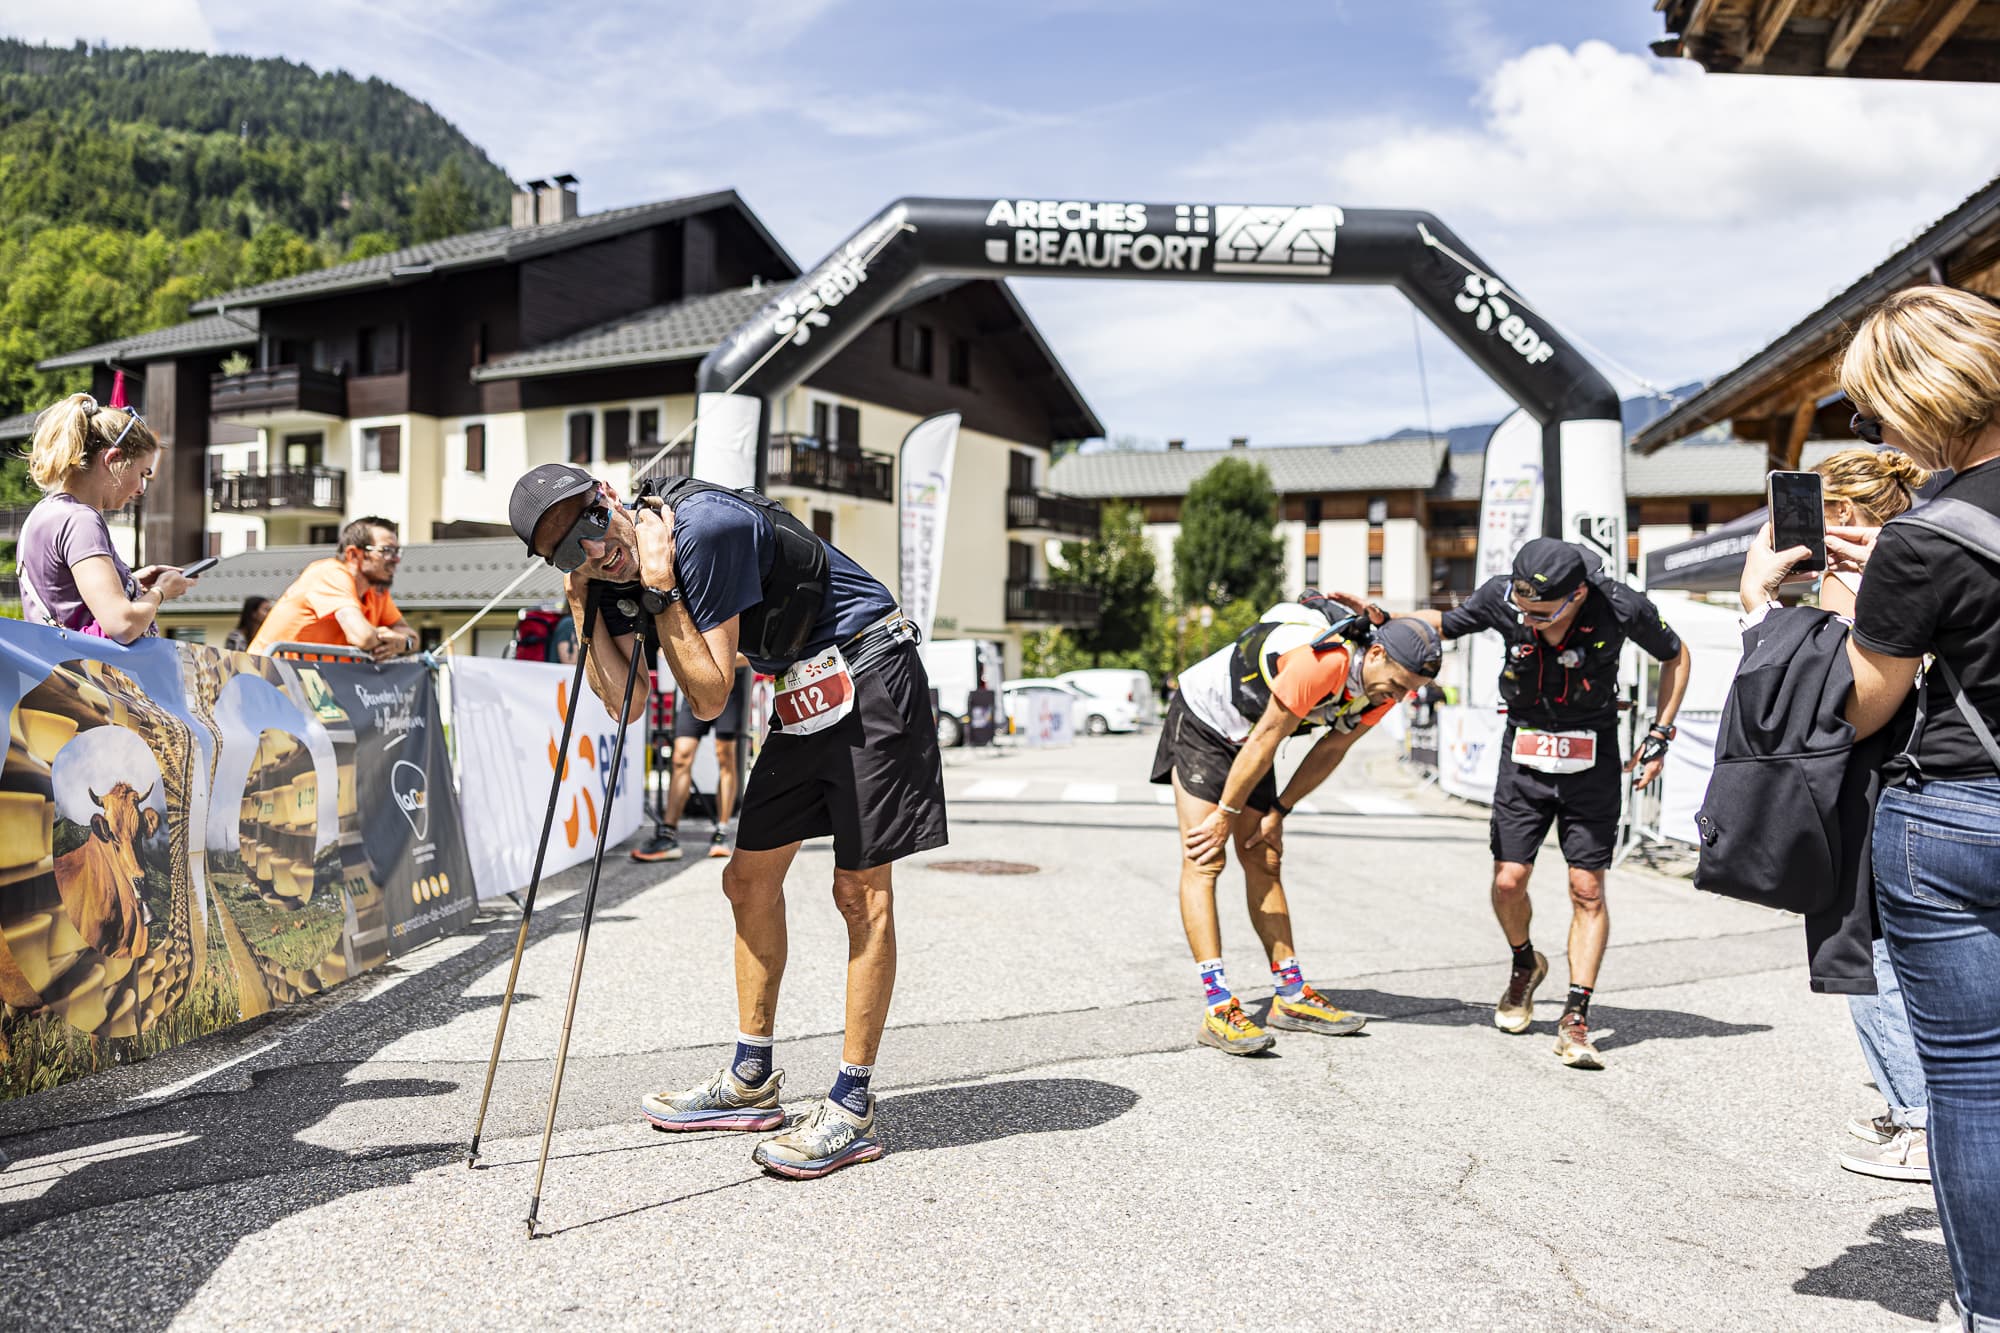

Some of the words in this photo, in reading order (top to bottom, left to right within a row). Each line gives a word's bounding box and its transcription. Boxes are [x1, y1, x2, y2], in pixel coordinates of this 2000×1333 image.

[985, 200, 1148, 232] ARECHES
[1015, 230, 1209, 271] BEAUFORT
[790, 686, 830, 719] 112
[1536, 735, 1570, 758] 216
[824, 1129, 856, 1154] HOKA
